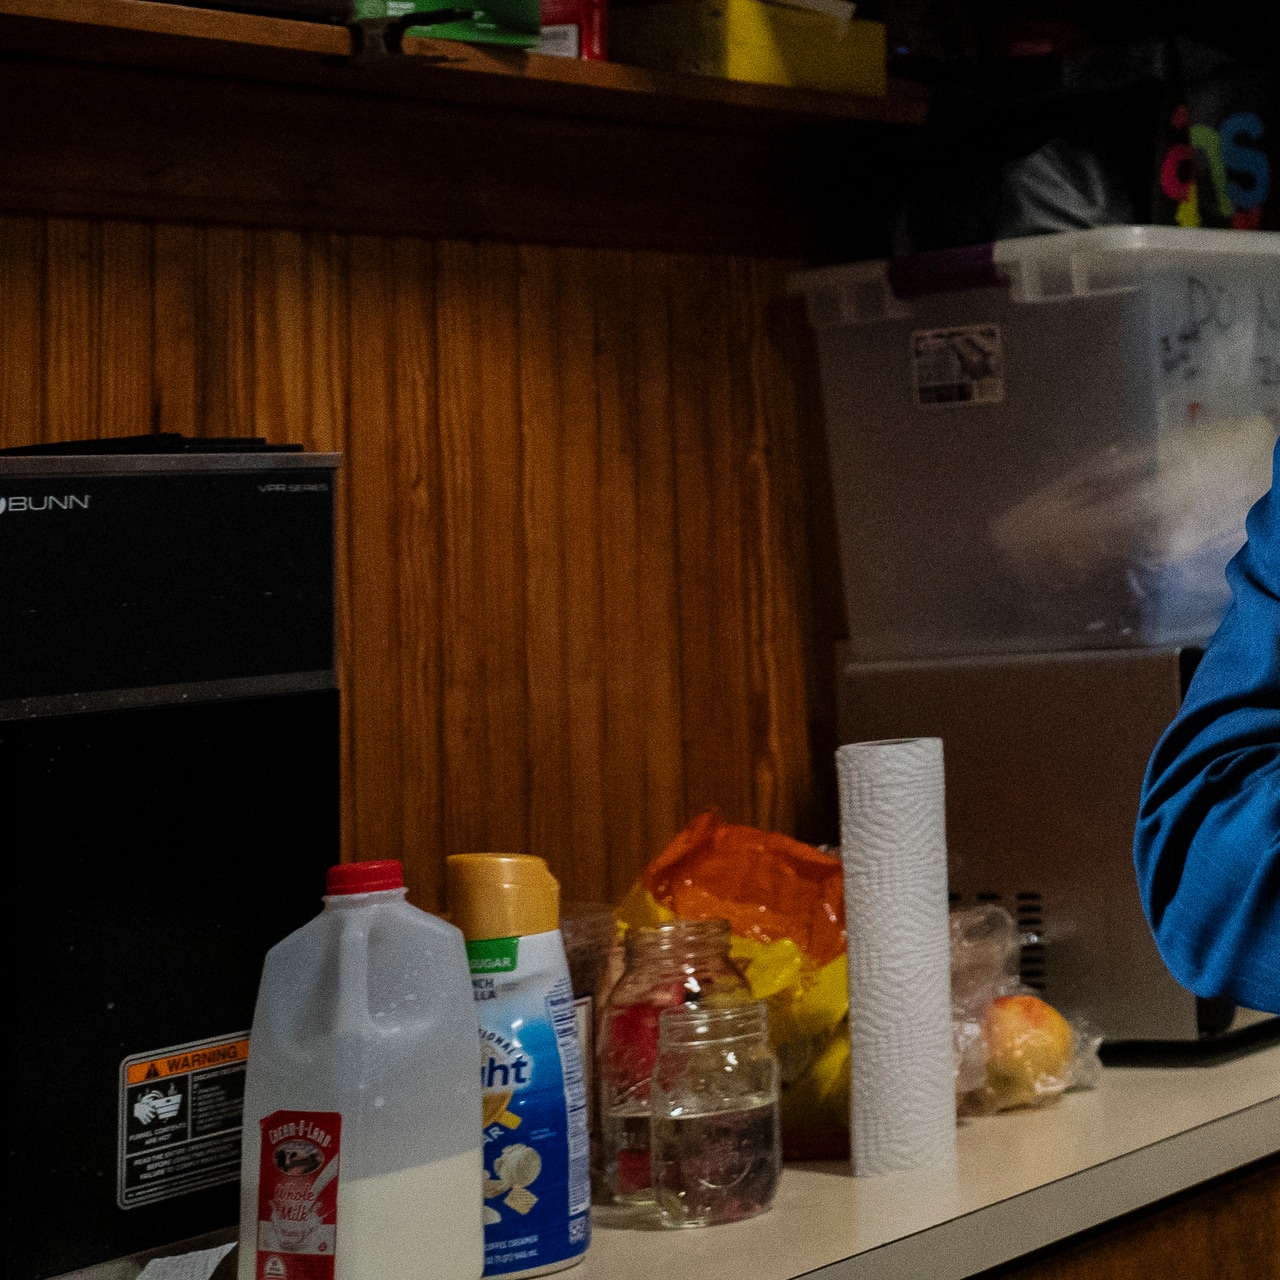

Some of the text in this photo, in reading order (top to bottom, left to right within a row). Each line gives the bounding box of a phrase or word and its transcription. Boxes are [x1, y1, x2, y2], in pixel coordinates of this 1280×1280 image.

[8, 495, 89, 511] BUNN
[167, 1045, 238, 1073] WARNING
[274, 1183, 314, 1201] Whole
[279, 1205, 310, 1221] Milk
